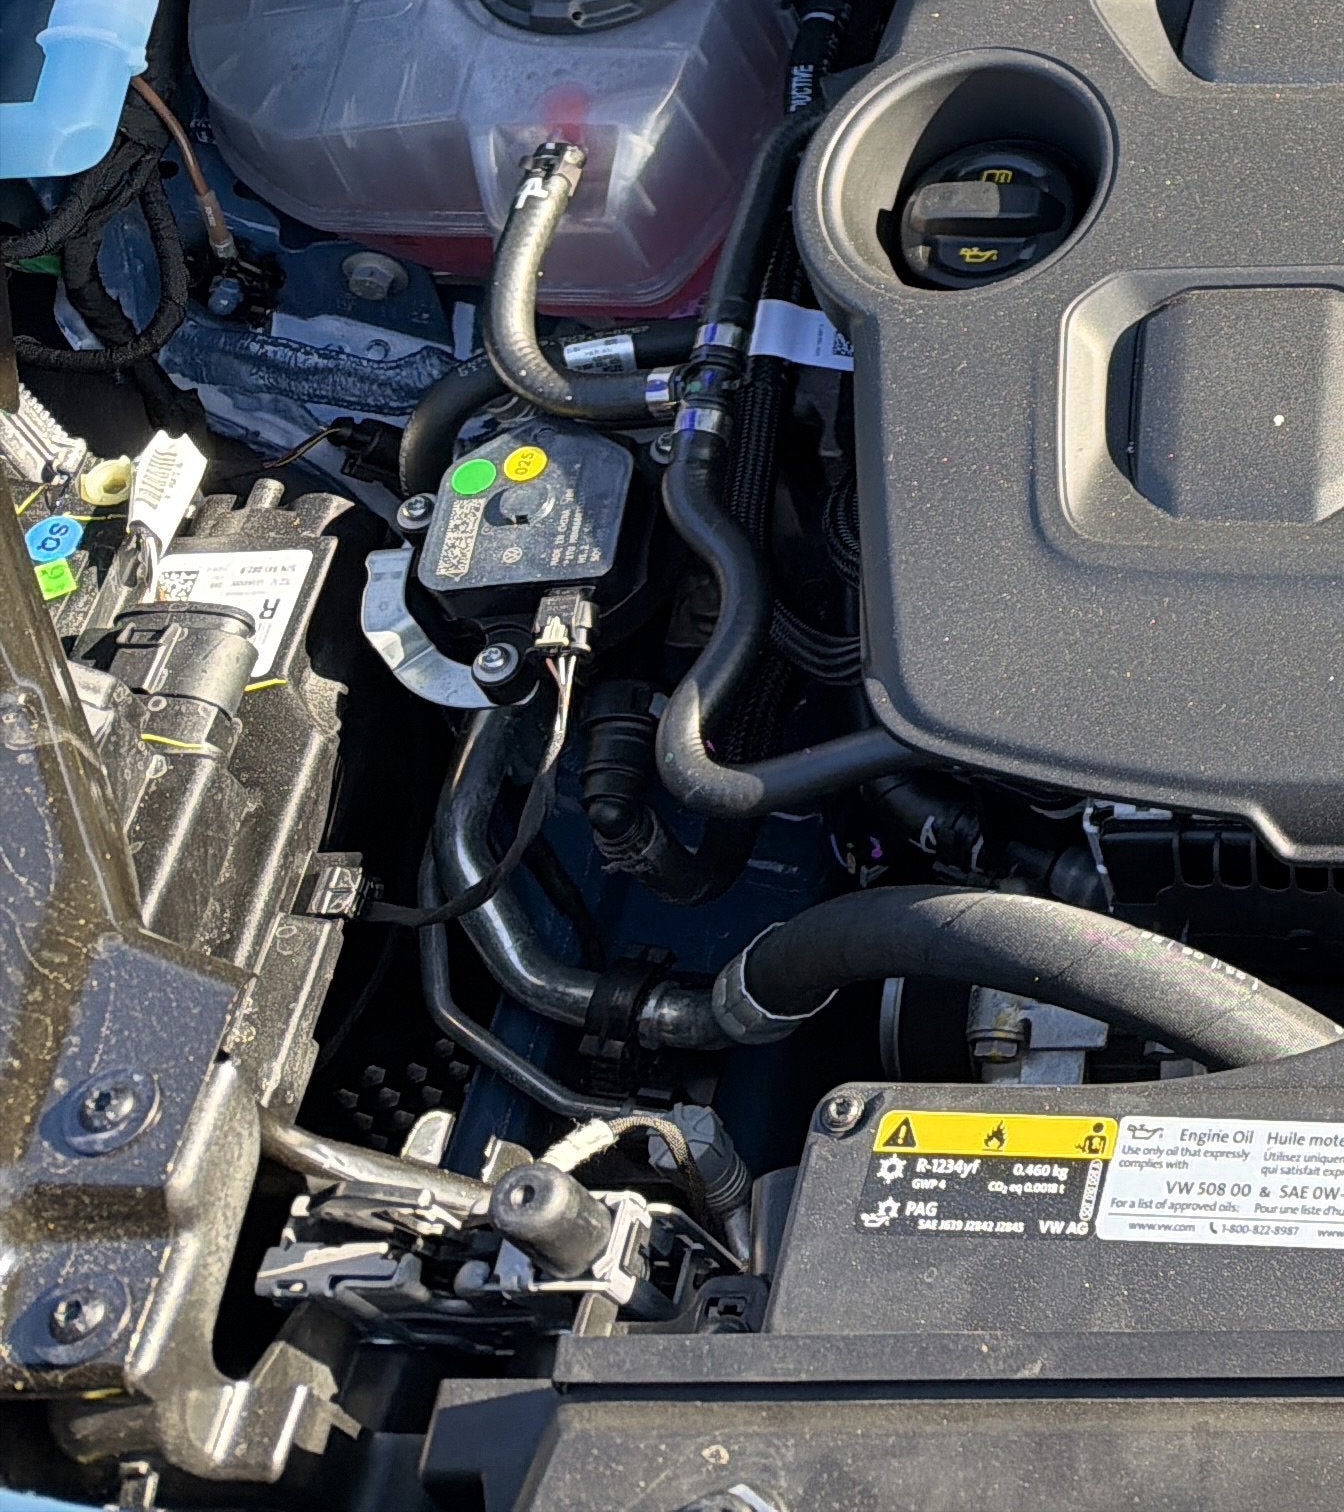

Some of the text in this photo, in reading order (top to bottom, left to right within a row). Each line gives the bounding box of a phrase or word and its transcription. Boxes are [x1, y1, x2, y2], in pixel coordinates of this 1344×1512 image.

[258, 599, 280, 620] R
[1180, 1128, 1254, 1146] Engine Oil
[1266, 1131, 1305, 1147] Huile
[1121, 1144, 1250, 1161] Use only oil that expressly
[1263, 1151, 1301, 1163] Utilisez
[916, 1158, 980, 1178] R-1234yf
[1013, 1164, 1069, 1181] 0.460 kg
[1119, 1159, 1189, 1171] complies with
[1260, 1166, 1278, 1178] qui
[1280, 1166, 1320, 1177] satisfait
[912, 1179, 936, 1190] GWP
[1166, 1180, 1194, 1196] VW
[1197, 1181, 1226, 1196] 508
[1230, 1182, 1252, 1197] 00
[1259, 1186, 1271, 1198] &
[1279, 1185, 1309, 1200] SAE
[905, 1201, 938, 1217] PAG
[1110, 1197, 1128, 1208] For
[1129, 1200, 1136, 1209] a
[1137, 1198, 1153, 1209] list
[1155, 1198, 1168, 1210] of
[1168, 1200, 1217, 1213] approved
[1254, 1203, 1278, 1214] Pour
[1279, 1205, 1299, 1215] une
[1301, 1205, 1322, 1216] liste
[1039, 1220, 1089, 1235] VW AG
[1128, 1222, 1195, 1232] www.vw.com
